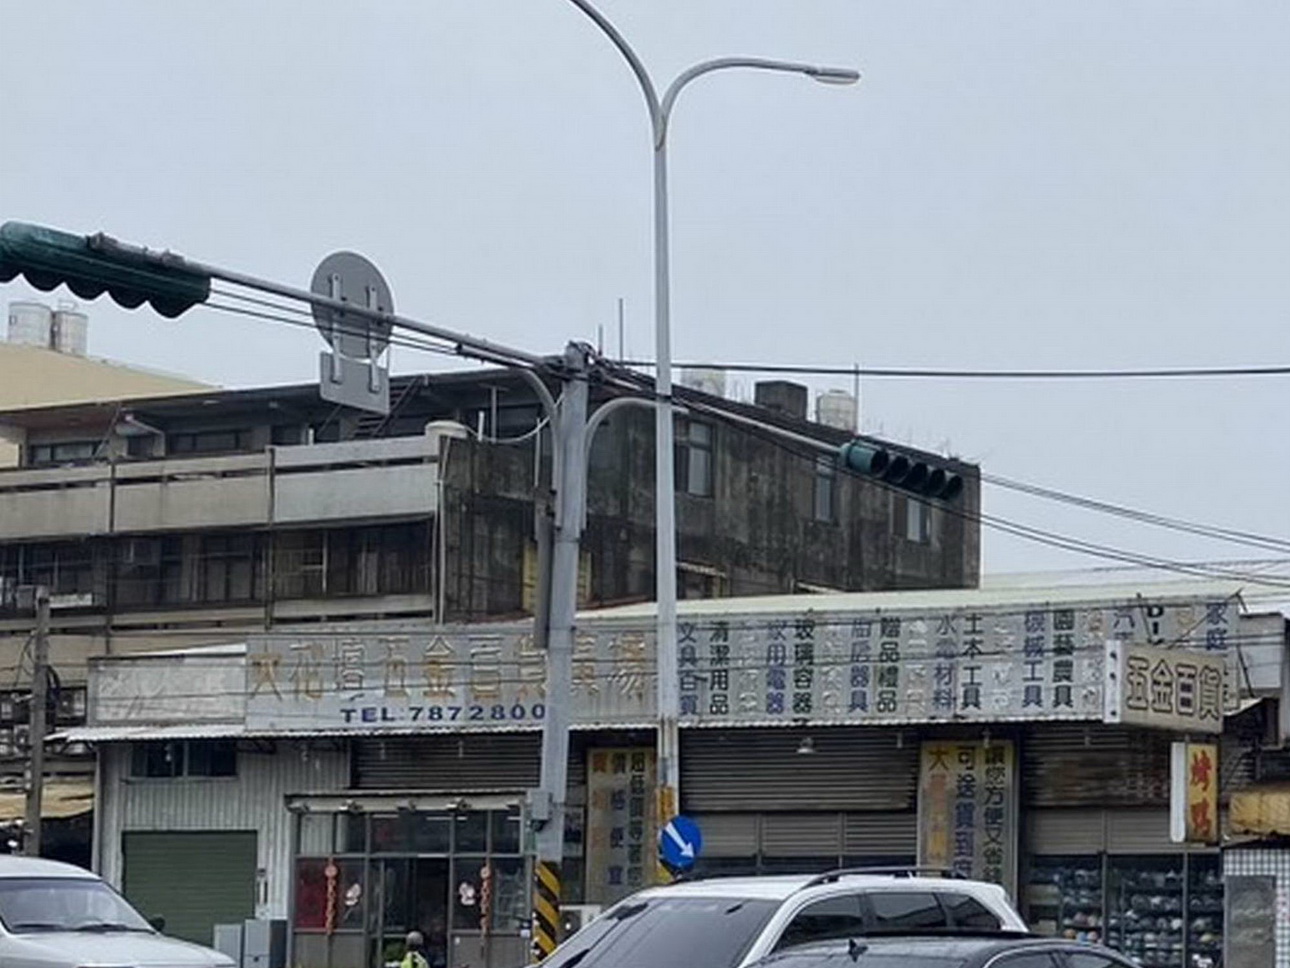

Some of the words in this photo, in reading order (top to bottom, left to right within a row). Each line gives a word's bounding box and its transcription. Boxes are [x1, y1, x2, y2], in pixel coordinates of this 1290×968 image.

[1126, 655, 1222, 721] 五金百貨
[408, 703, 547, 722] 7872800
